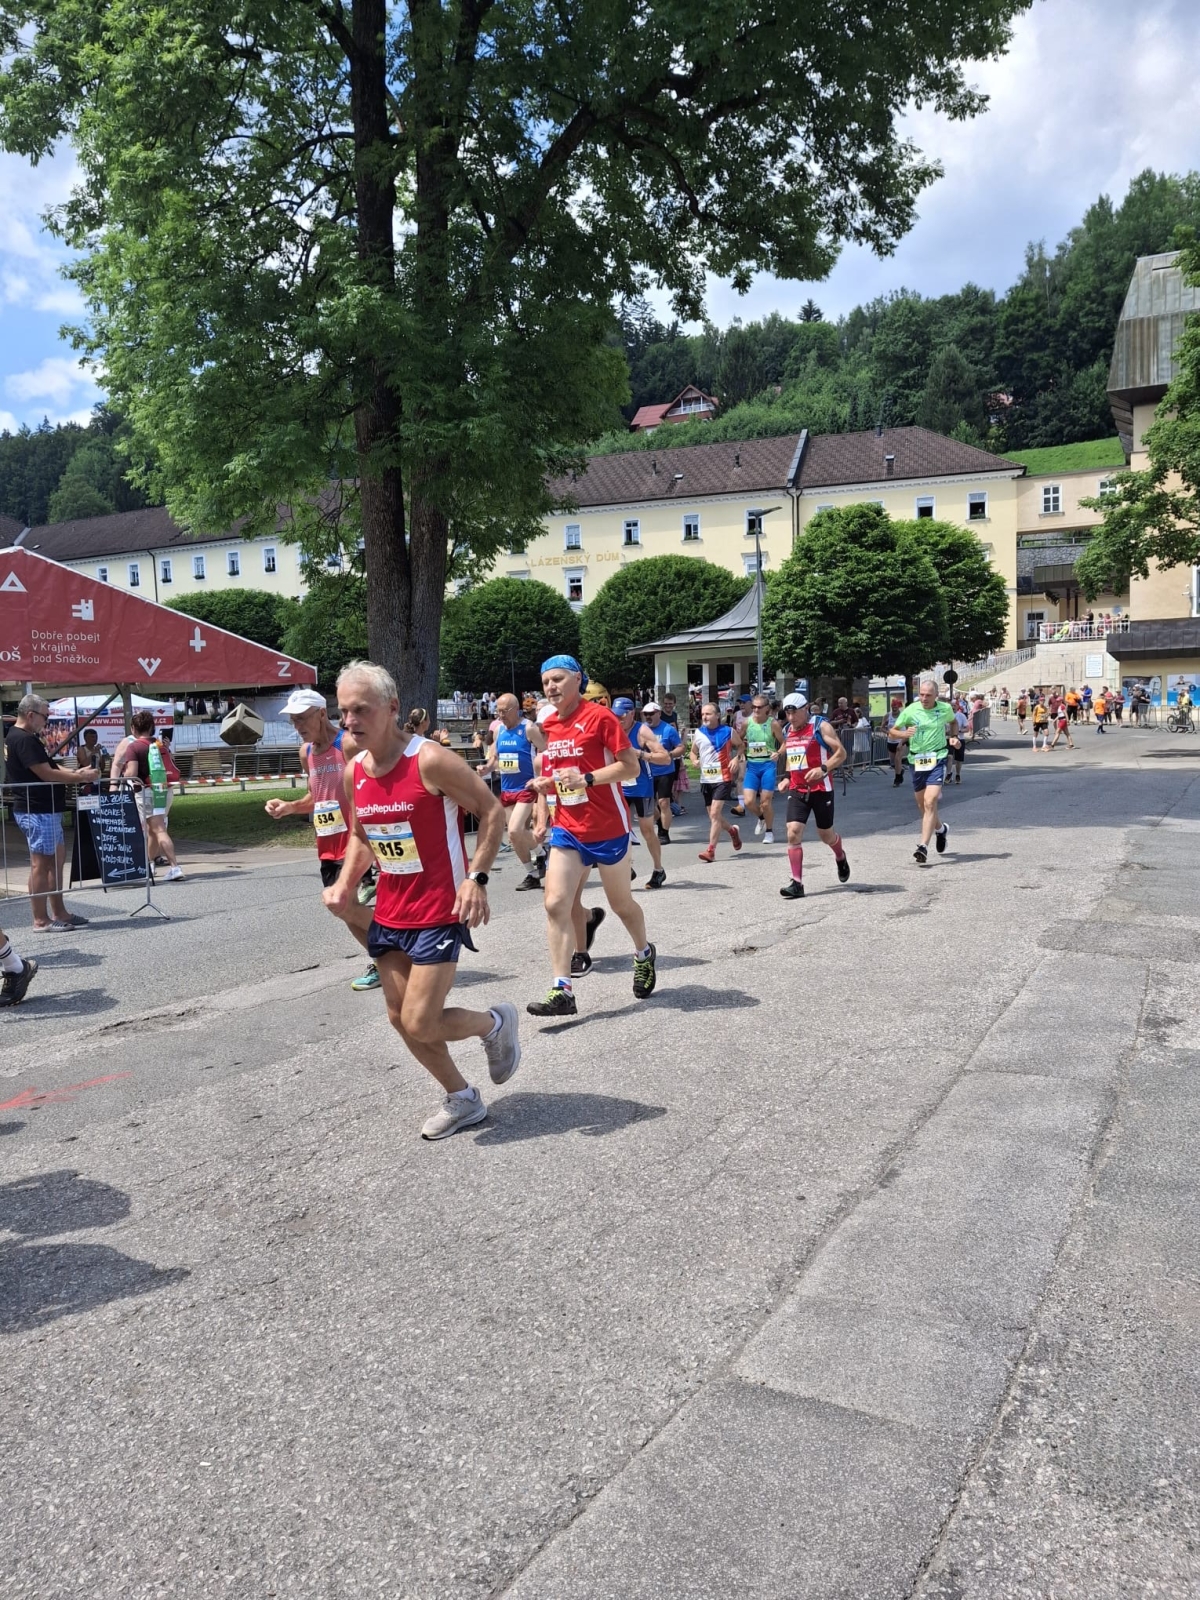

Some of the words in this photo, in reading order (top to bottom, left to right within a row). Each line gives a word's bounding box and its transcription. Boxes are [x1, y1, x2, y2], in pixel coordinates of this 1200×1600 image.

[530, 552, 591, 567] LÁZEŇSKÝ
[596, 550, 620, 563] DŮM
[31, 629, 63, 640] Dobře
[66, 632, 100, 643] pobejt
[32, 643, 38, 651] v
[40, 642, 77, 653] Krajině
[33, 654, 52, 664] pod
[55, 653, 100, 664] Sněžkou
[548, 739, 575, 750] CZECH
[548, 747, 584, 760] EPUBLIC
[317, 812, 335, 825] 534
[378, 841, 404, 857] 815
